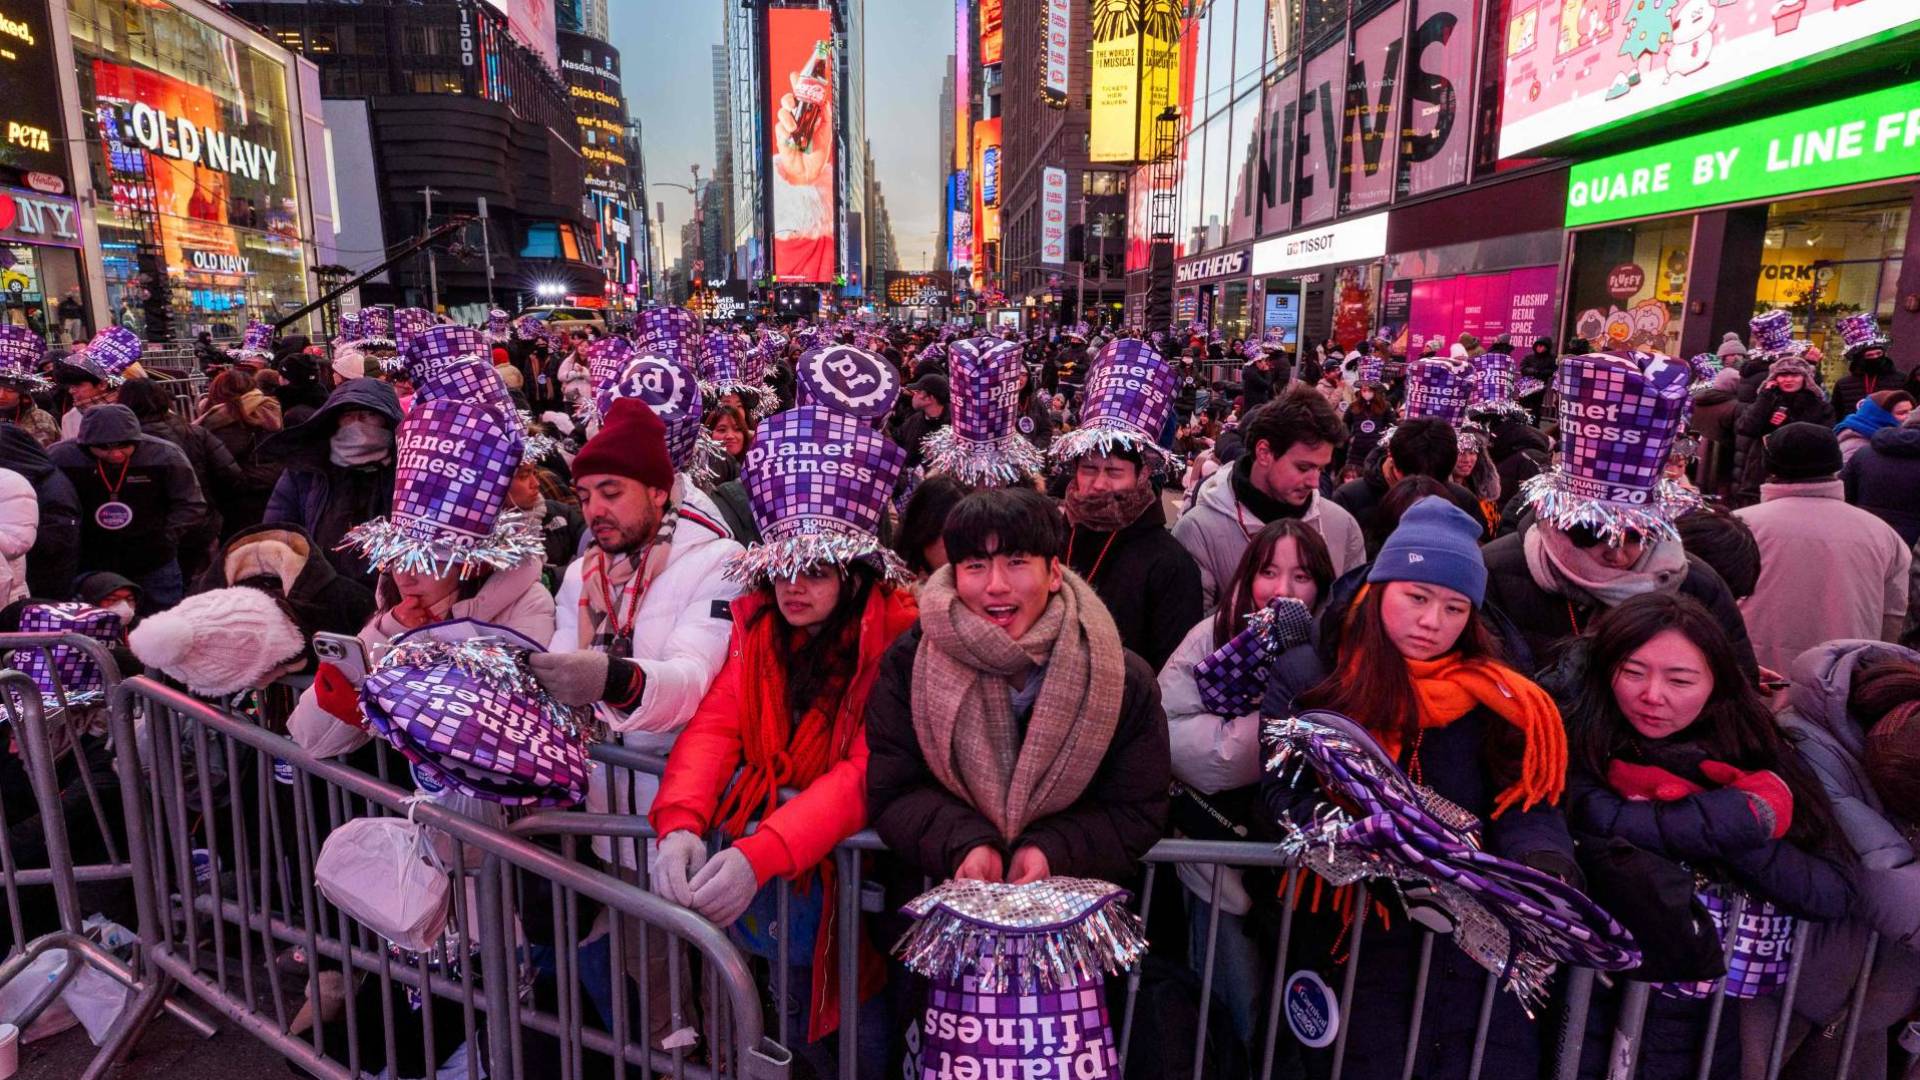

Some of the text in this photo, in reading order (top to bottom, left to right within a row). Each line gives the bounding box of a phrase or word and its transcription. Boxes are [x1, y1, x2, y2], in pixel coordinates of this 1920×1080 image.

[460, 9, 474, 66] 1500
[561, 59, 595, 75] Nasdaq
[1103, 57, 1136, 68] MUSICAL
[571, 86, 595, 99] Dick
[131, 101, 200, 163] OLD
[203, 126, 277, 185] NAVY
[1766, 121, 1866, 172] LINE
[1692, 148, 1740, 186] BY
[1300, 234, 1336, 254] TISSOT
[194, 252, 250, 273] OLD NAVY
[1176, 251, 1245, 283] SKECHERS
[1610, 273, 1641, 288] FLUFFY
[901, 296, 938, 305] 2026
[1513, 294, 1549, 307] FLAGSHIP
[1511, 308, 1535, 321] RETAIL
[1510, 321, 1533, 334] SPACE
[1524, 335, 1541, 348] LEA
[825, 354, 876, 391] pf
[746, 439, 855, 471] planet
[957, 440, 996, 453] 2026
[761, 456, 873, 484] fitness
[1611, 487, 1648, 504] 20
[404, 680, 550, 743] fitness
[429, 698, 568, 766] planet
[923, 1007, 1080, 1056] fitness
[937, 1038, 1106, 1080] planet
